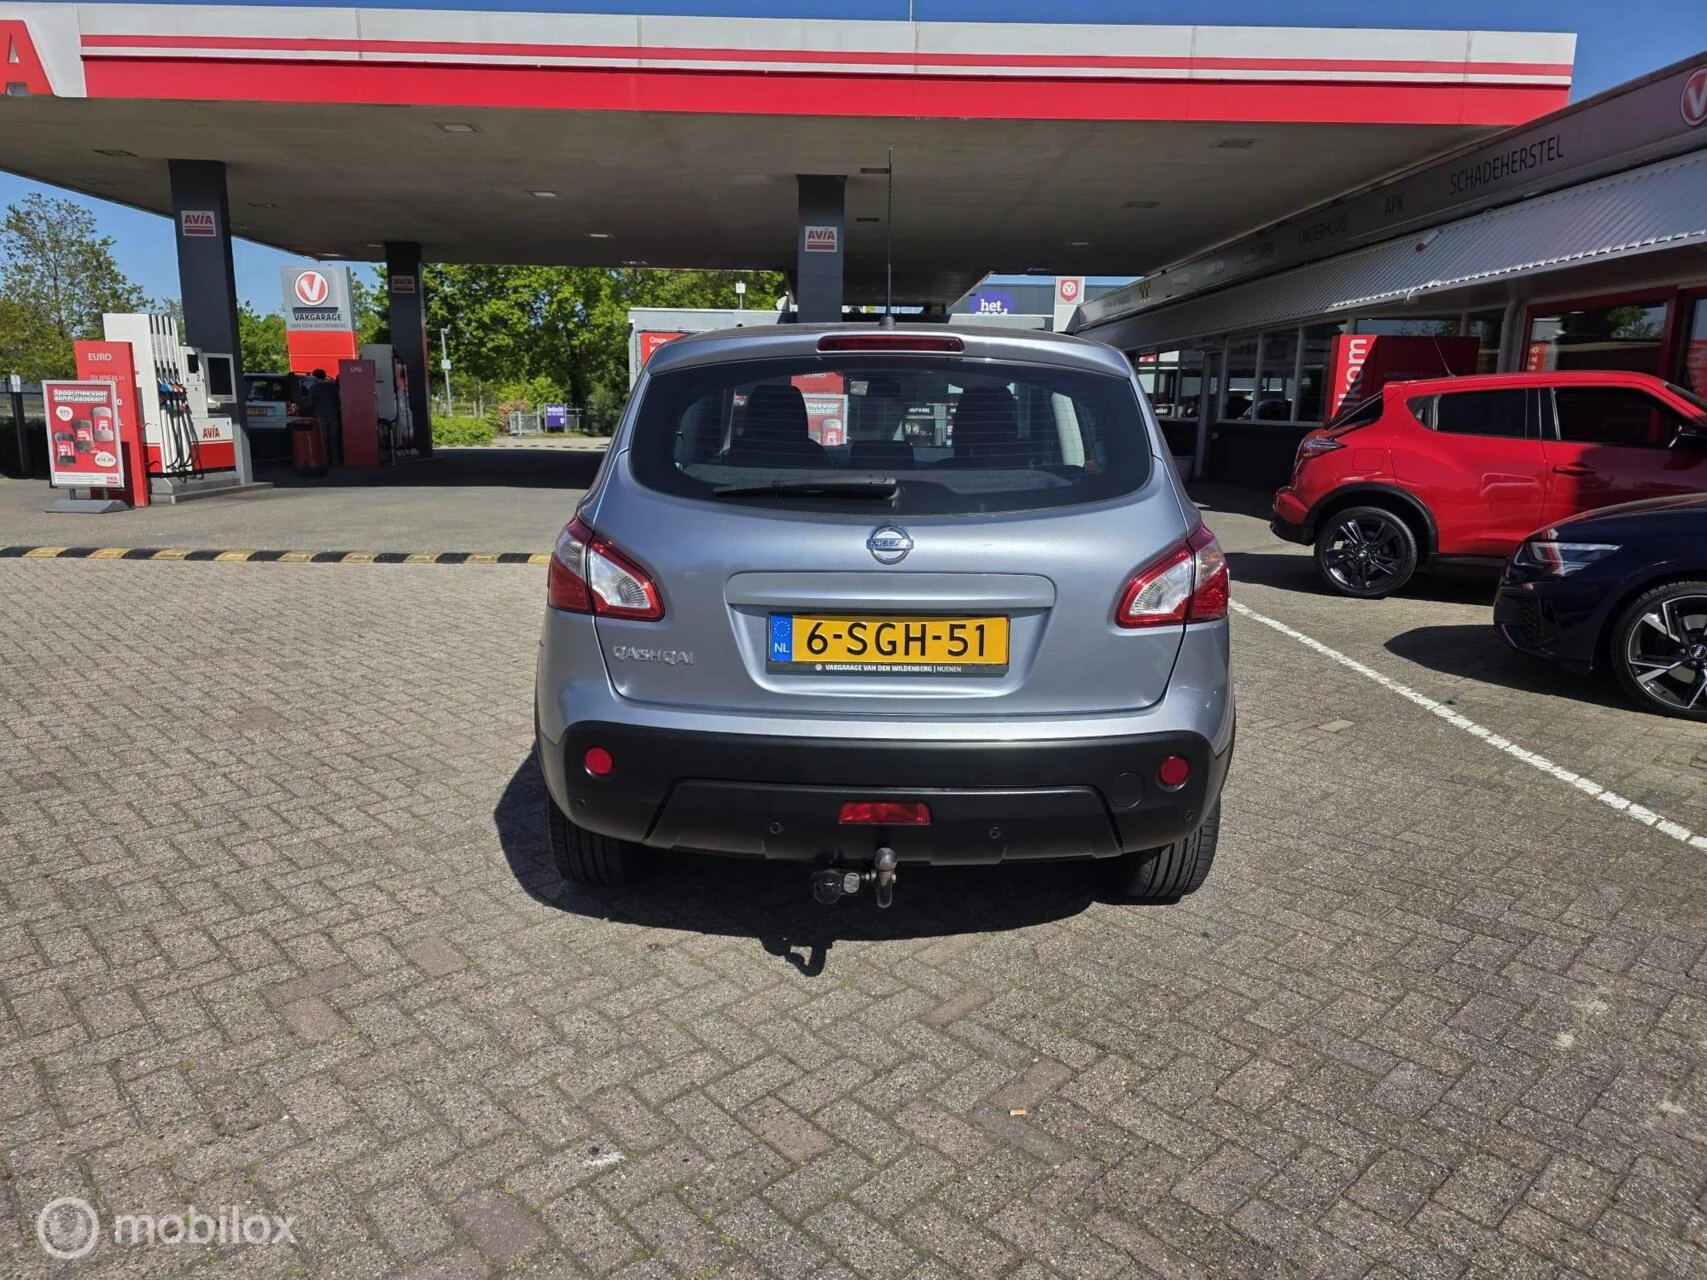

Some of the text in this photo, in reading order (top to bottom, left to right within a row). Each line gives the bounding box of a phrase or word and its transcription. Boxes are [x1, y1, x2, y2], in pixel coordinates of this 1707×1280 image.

[1449, 135, 1564, 196] SCHADEHERSTEL
[1384, 192, 1405, 217] APK
[980, 297, 1002, 311] het
[294, 313, 342, 321] VAKGARAGE
[88, 353, 113, 361] EURO
[806, 622, 984, 656] 6-SGH-51
[774, 643, 790, 653] NL
